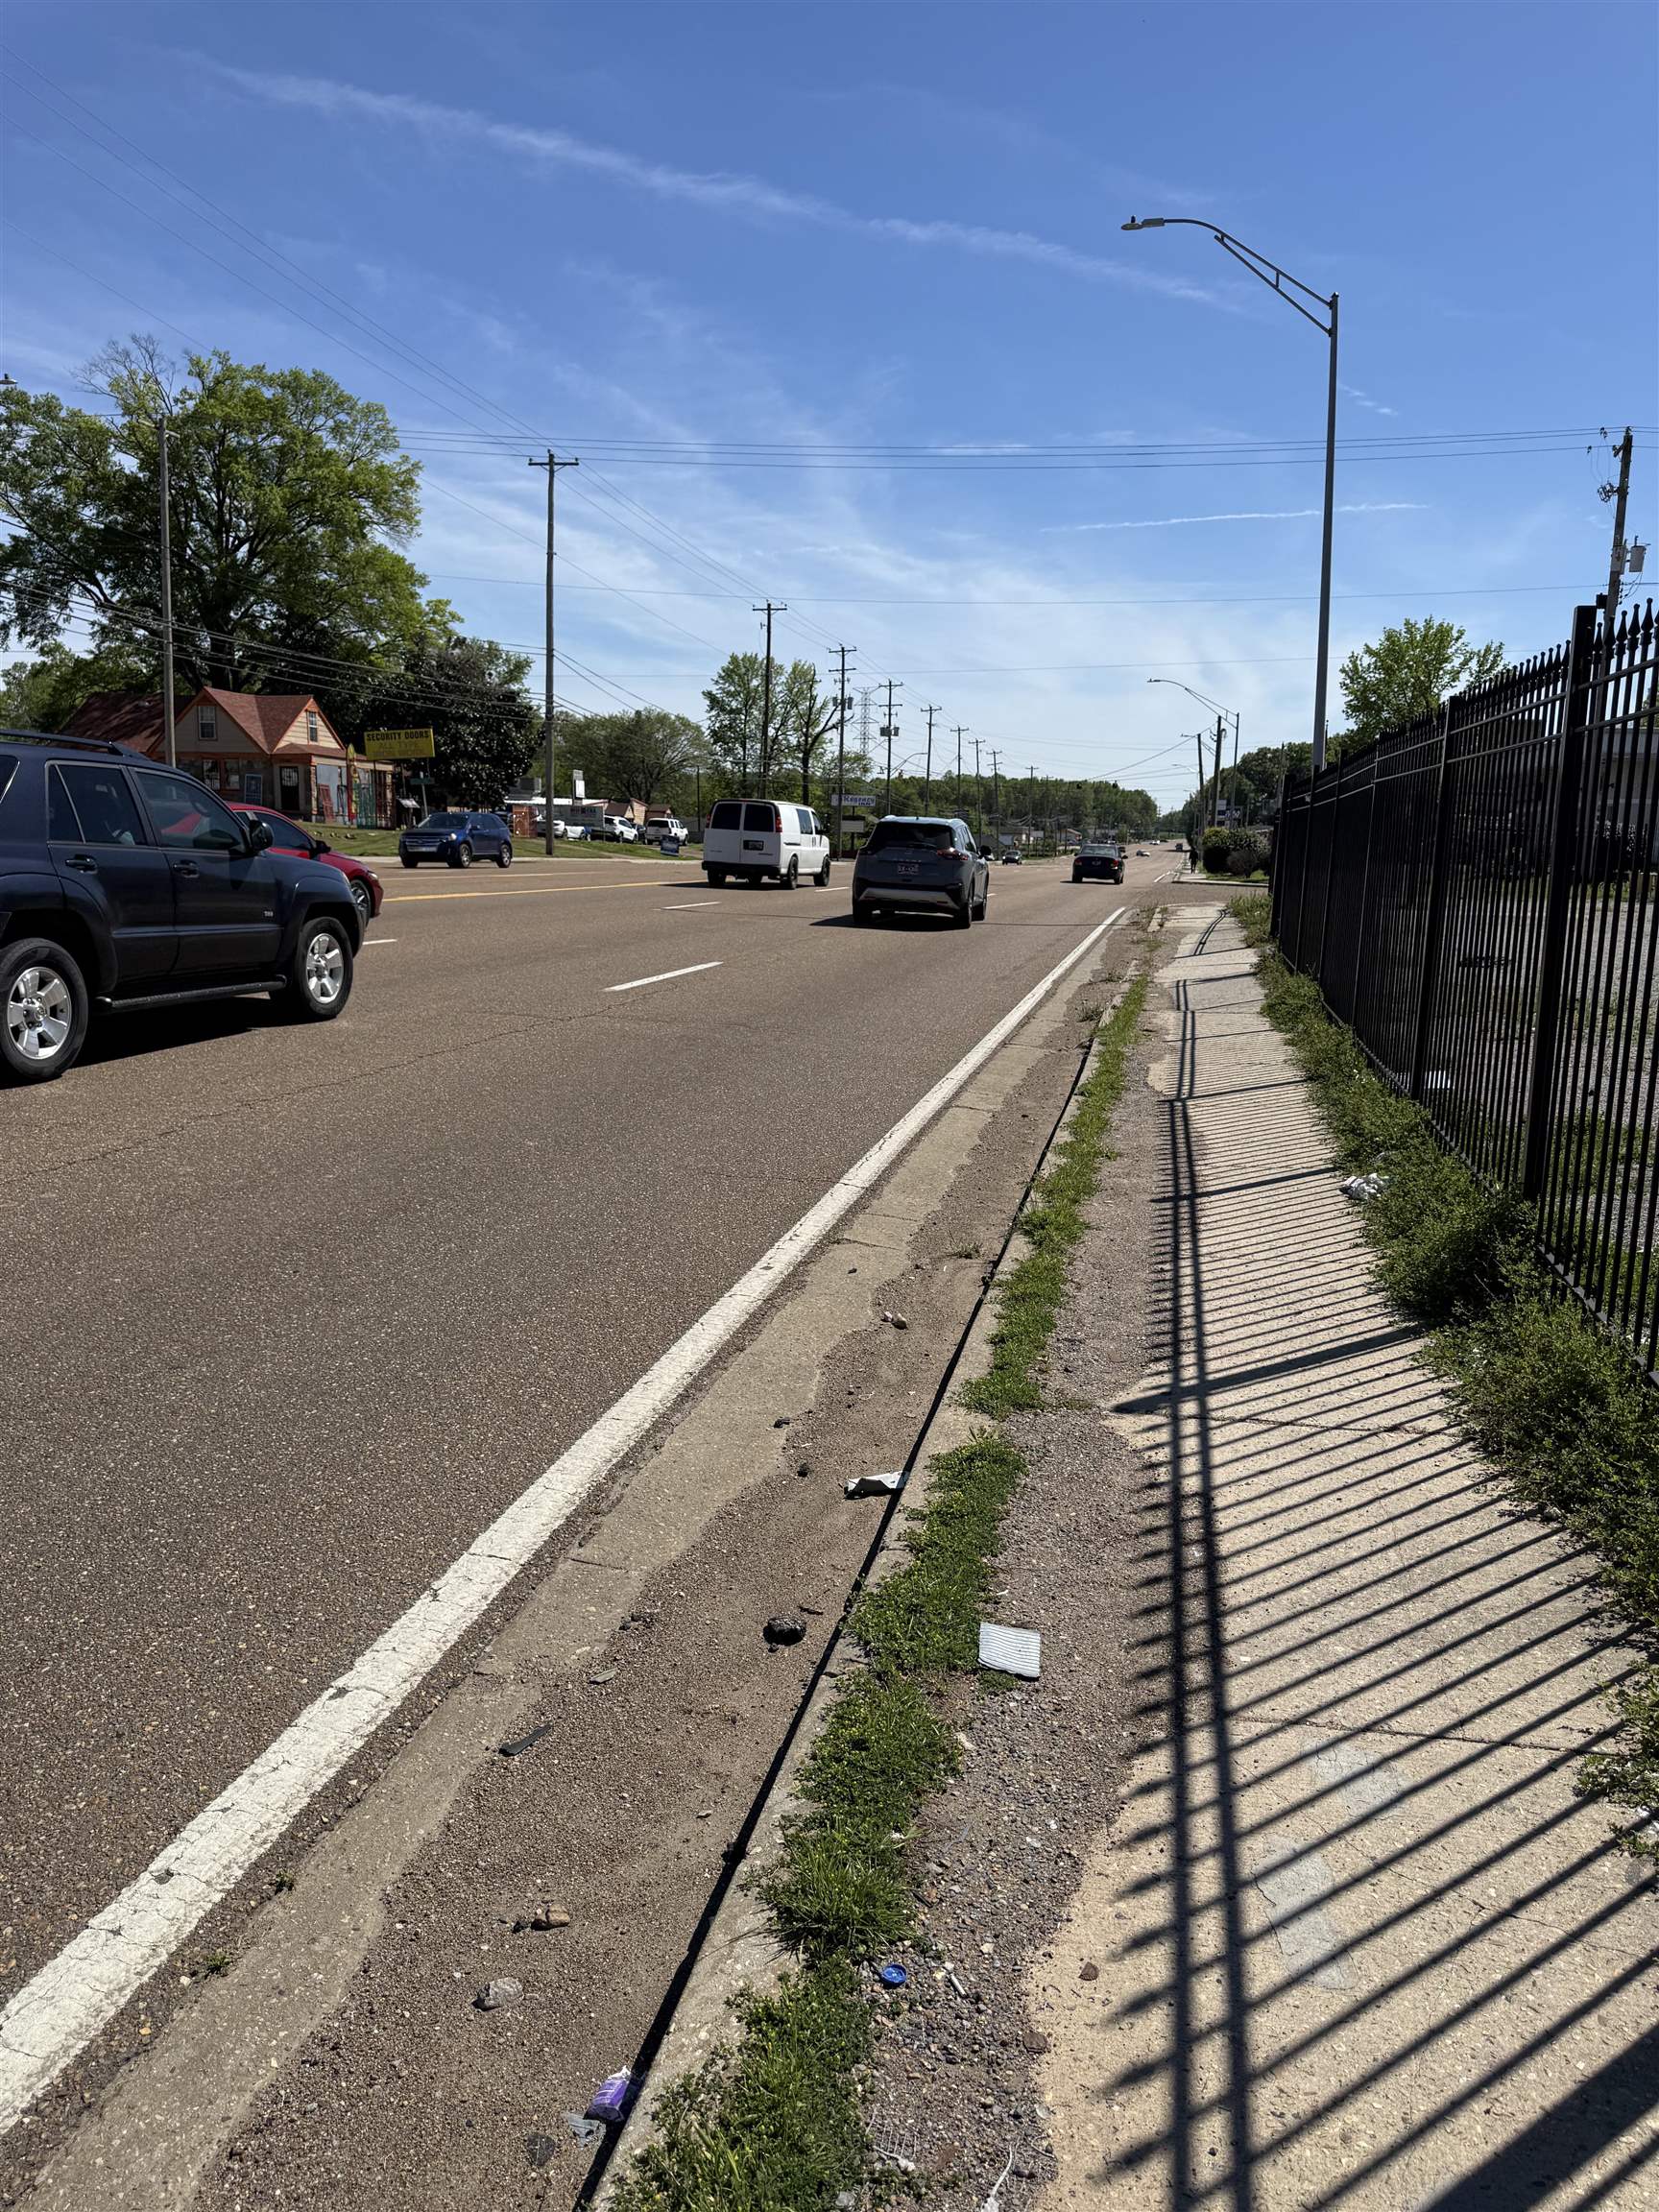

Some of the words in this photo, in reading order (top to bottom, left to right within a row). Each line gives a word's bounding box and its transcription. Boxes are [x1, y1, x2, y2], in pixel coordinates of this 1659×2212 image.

[367, 732, 401, 741] SECURITY
[404, 730, 429, 739] DOORS
[843, 795, 875, 805] Regency
